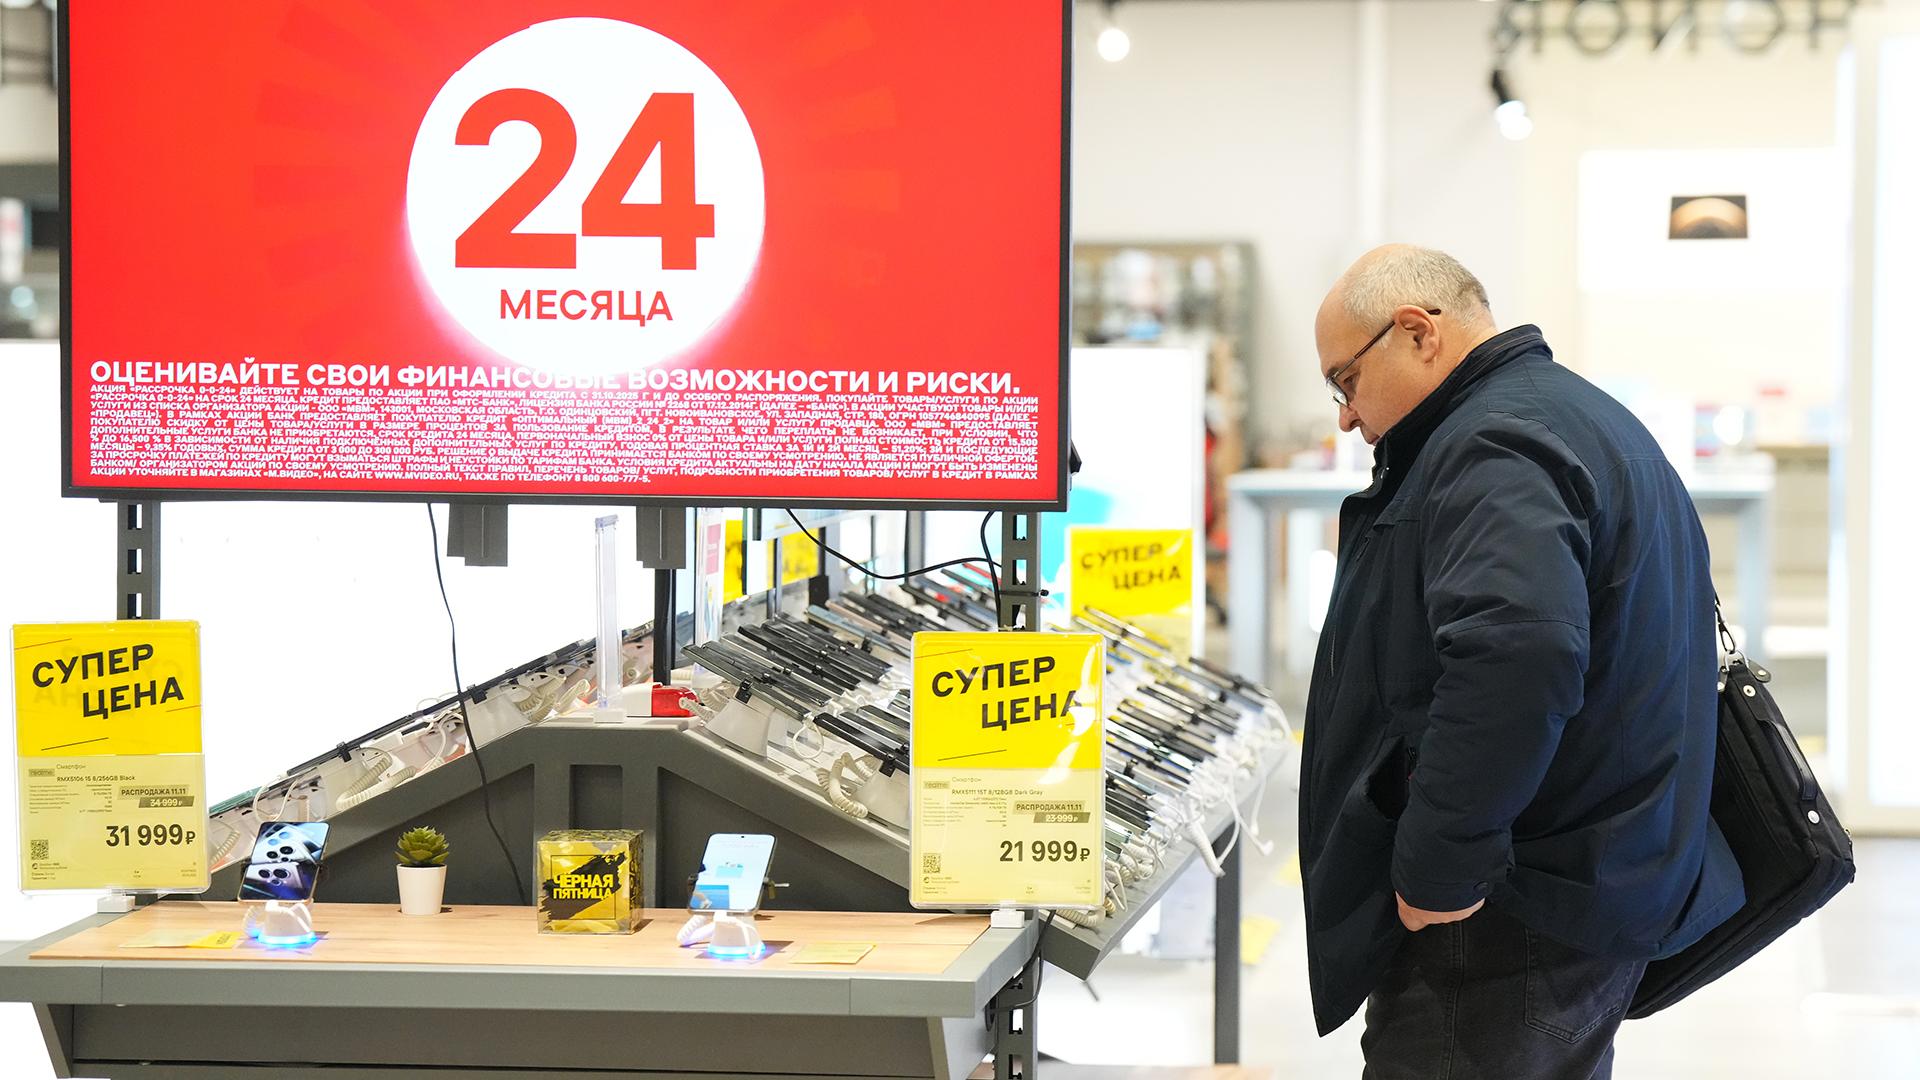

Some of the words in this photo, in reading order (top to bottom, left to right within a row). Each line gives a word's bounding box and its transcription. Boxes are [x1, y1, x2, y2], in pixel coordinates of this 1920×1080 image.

[455, 88, 715, 270] 24
[500, 289, 673, 327] МЕСЯЦА
[90, 357, 299, 386] ОЦЕНИВАЙТЕ
[306, 364, 389, 386] СВОИ
[397, 365, 620, 388] ФИНАНСОВЫЕ
[628, 369, 869, 391] ВОЗМОЖНОСТИ
[878, 371, 898, 393] И
[907, 372, 1020, 394] РИСКИ.
[90, 385, 126, 394] АКЦИЯ
[239, 386, 299, 396] ДЕЙСТВУЕТ
[322, 388, 365, 396] ТОВАРЫ
[387, 389, 423, 397] АКЦИИ
[451, 390, 526, 398] ОФОРМЛЕНИИ
[529, 391, 577, 400] КРЕДИТА
[664, 393, 680, 401] ДО
[683, 393, 732, 401] ОСОБОГО
[825, 394, 888, 403] ПОКУПАЙТЕ
[892, 396, 980, 405] ТОВАРЫ/УСЛУГИ
[1002, 397, 1039, 406] АКЦИИ
[178, 411, 221, 419] РАМКАХ
[226, 412, 262, 420] АКЦИИ
[266, 412, 295, 420] БАНК
[299, 413, 386, 422] ПРЕДОСТАВЛЯЕТ
[391, 414, 462, 422] ПОКУПАТЕЛЮ
[465, 415, 507, 423] КРЕДИТ
[90, 418, 161, 426] ПОКУПАТЕЛЮ
[166, 419, 208, 428] СКИДКУ
[233, 420, 264, 428] ЦЕНЫ
[270, 421, 354, 430] ТОВАРА/УСЛУГИ
[425, 423, 488, 431] ПРОЦЕНТОВ
[493, 423, 507, 431] ЗА
[512, 424, 588, 432] ПОЛЬЗОВАНИЕ
[671, 426, 735, 434] РЕЗУЛЬТАТЕ
[773, 427, 837, 435] ПЕРЕПЛАТЫ
[931, 429, 953, 437] ПРИ
[1017, 430, 1038, 438] ЧТО
[90, 459, 137, 468] БАНКОМ/
[139, 460, 228, 468] ОРГАНИЗАТОРОМ
[230, 461, 266, 470] АКЦИИ
[285, 462, 327, 470] СВОЕМУ
[405, 463, 451, 471] ПОЛНЫЙ
[453, 464, 485, 472] ТЕКСТ
[533, 465, 587, 473] ПЕРЕЧЕНЬ
[589, 466, 640, 475] ТОВАРОВ/
[679, 467, 757, 476] ПОДРОБНОСТИ
[758, 468, 840, 476] ПРИОБРЕТЕНИЯ
[842, 469, 894, 478] ТОВАРОВ/
[896, 470, 929, 478] УСЛУГ
[941, 471, 983, 479] КРЕДИТ
[994, 471, 1037, 479] РАМКАХ
[105, 451, 166, 459] ПРОСРОЧКУ
[168, 451, 225, 460] ПЛАТЕЖЕЙ
[241, 453, 289, 462] КРЕДИТУ
[326, 454, 390, 462] ВЗЫМАТЬСЯ
[391, 455, 439, 463] ШТРАФЫ
[448, 455, 510, 464] НЕУСТОЙКИ
[527, 457, 577, 465] ТАРИФАМ
[616, 458, 665, 466] УСЛОВИЯ
[666, 459, 713, 467] КРЕДИТА
[714, 459, 778, 467] АКТУАЛЬНЫ
[794, 460, 821, 469] ДАТУ
[865, 461, 902, 470] АКЦИИ
[978, 463, 1038, 471] ИЗМЕНЕНЫ
[90, 468, 126, 476] АКЦИИ
[127, 467, 189, 476] УТОЧНЯЙТЕ
[198, 469, 261, 477] МАГАЗИНАХ
[339, 470, 373, 478] САЙТЕ
[517, 473, 572, 481] ТЕЛЕФОНУ
[1081, 543, 1162, 569] СУПЕР
[1113, 565, 1181, 590] ЦЕНА
[32, 643, 154, 688] СУПЕР
[932, 656, 1056, 697] СУПЕР
[82, 676, 185, 720] ЦЕНА
[1029, 789, 1043, 797] Gray
[1016, 804, 1066, 812] РАСПРОДАЖА
[106, 825, 130, 847] 31
[1000, 841, 1024, 862] 21
[553, 888, 613, 900] ПЯТНИЦА
